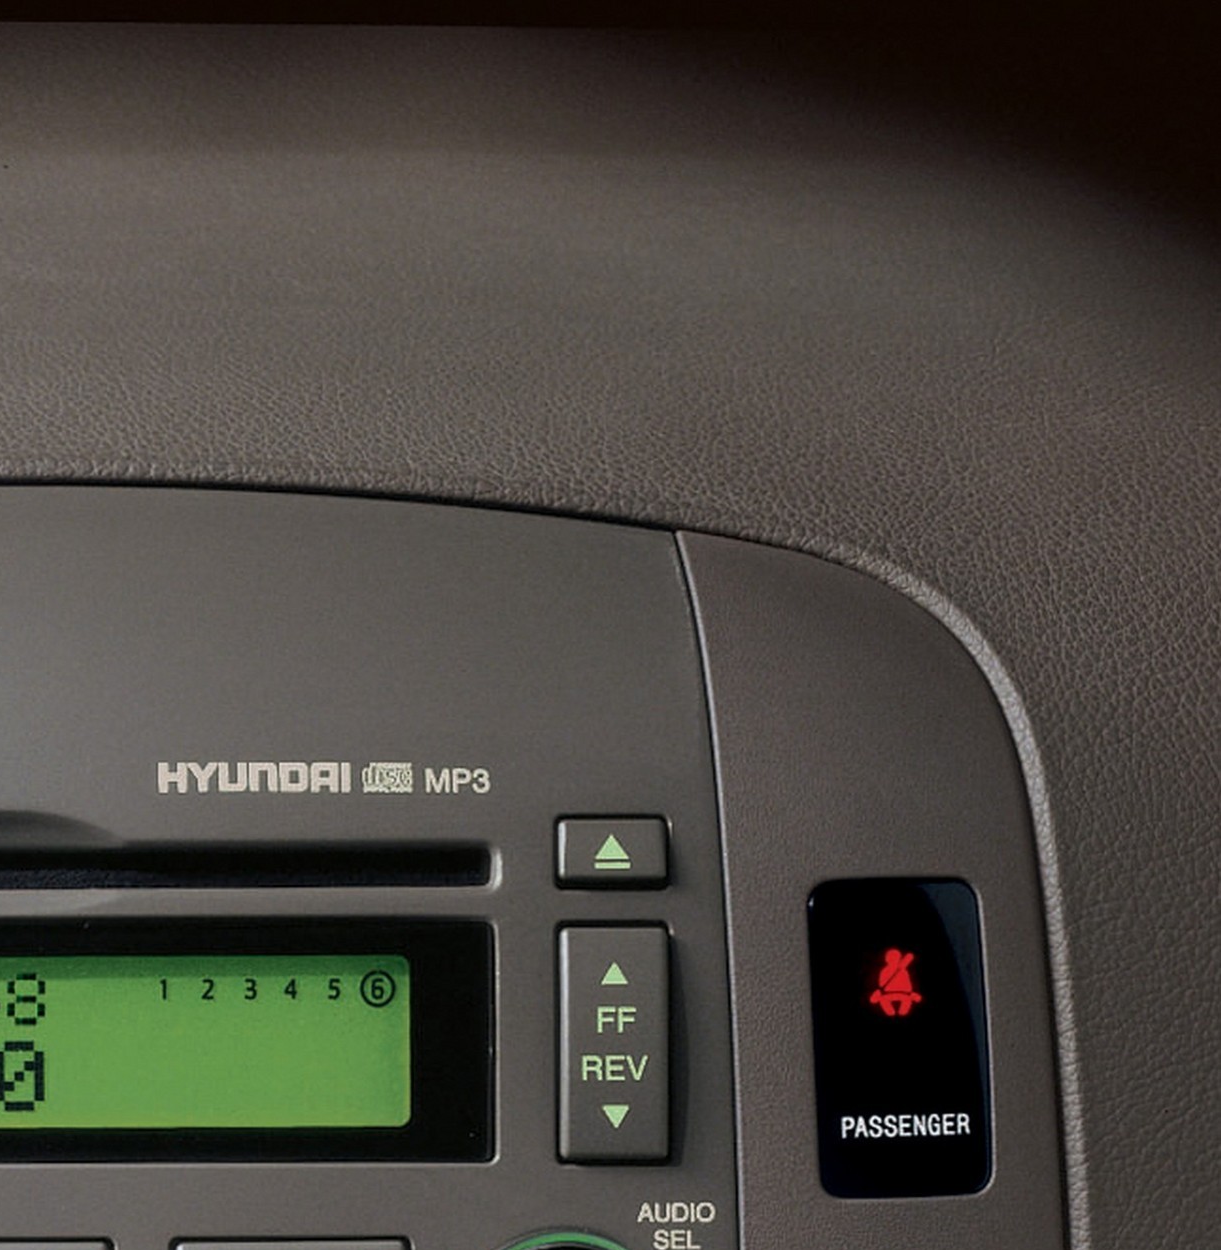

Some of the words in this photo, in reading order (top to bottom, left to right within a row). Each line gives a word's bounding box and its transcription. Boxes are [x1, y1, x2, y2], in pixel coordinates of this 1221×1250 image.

[158, 762, 351, 793] HYUNDAI
[426, 768, 491, 794] MP3
[160, 978, 168, 1000] 1
[201, 978, 215, 1000] 2
[243, 978, 257, 1000] 3
[283, 978, 298, 1000] 4
[327, 978, 341, 1000] 5
[597, 1007, 636, 1032] FF
[582, 1056, 648, 1081] REV
[841, 1114, 970, 1138] PASSENGER
[637, 1202, 715, 1223] AUDIO
[653, 1230, 701, 1250] SEL
